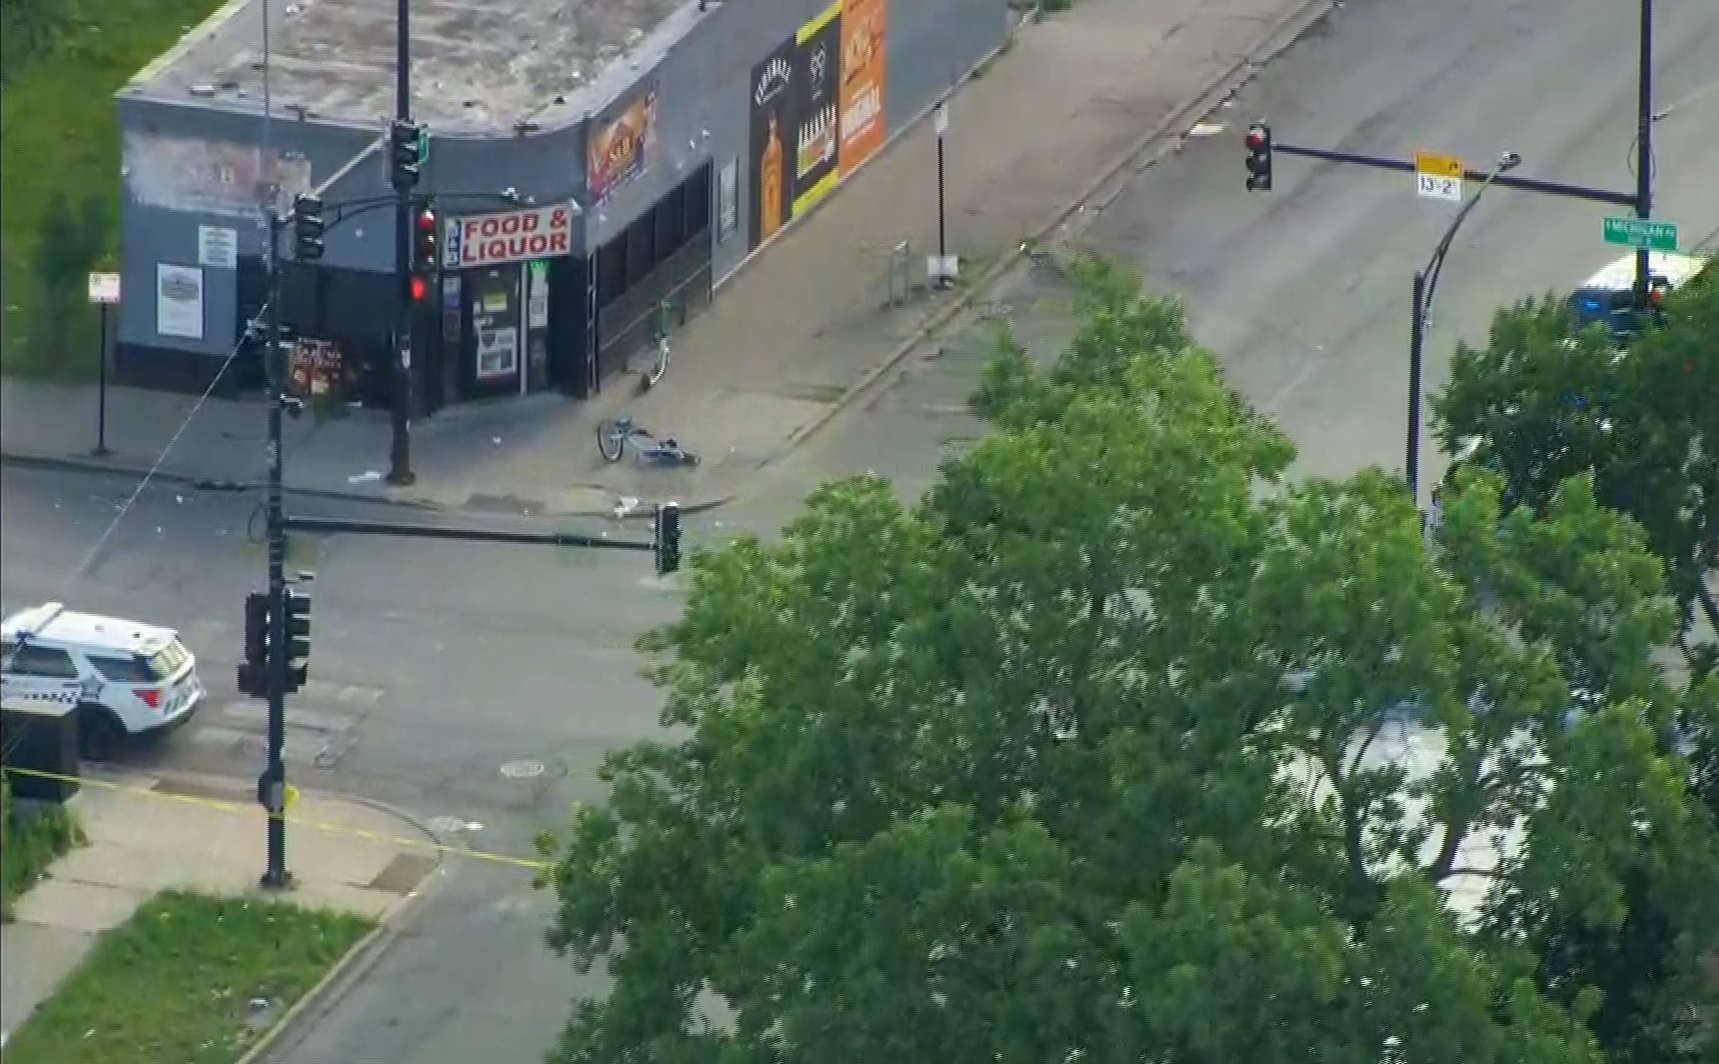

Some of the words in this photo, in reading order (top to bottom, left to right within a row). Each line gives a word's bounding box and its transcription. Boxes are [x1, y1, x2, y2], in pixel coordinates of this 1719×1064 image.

[464, 213, 540, 240] FOOD
[550, 209, 567, 230] &
[462, 231, 567, 263] LIQUOR
